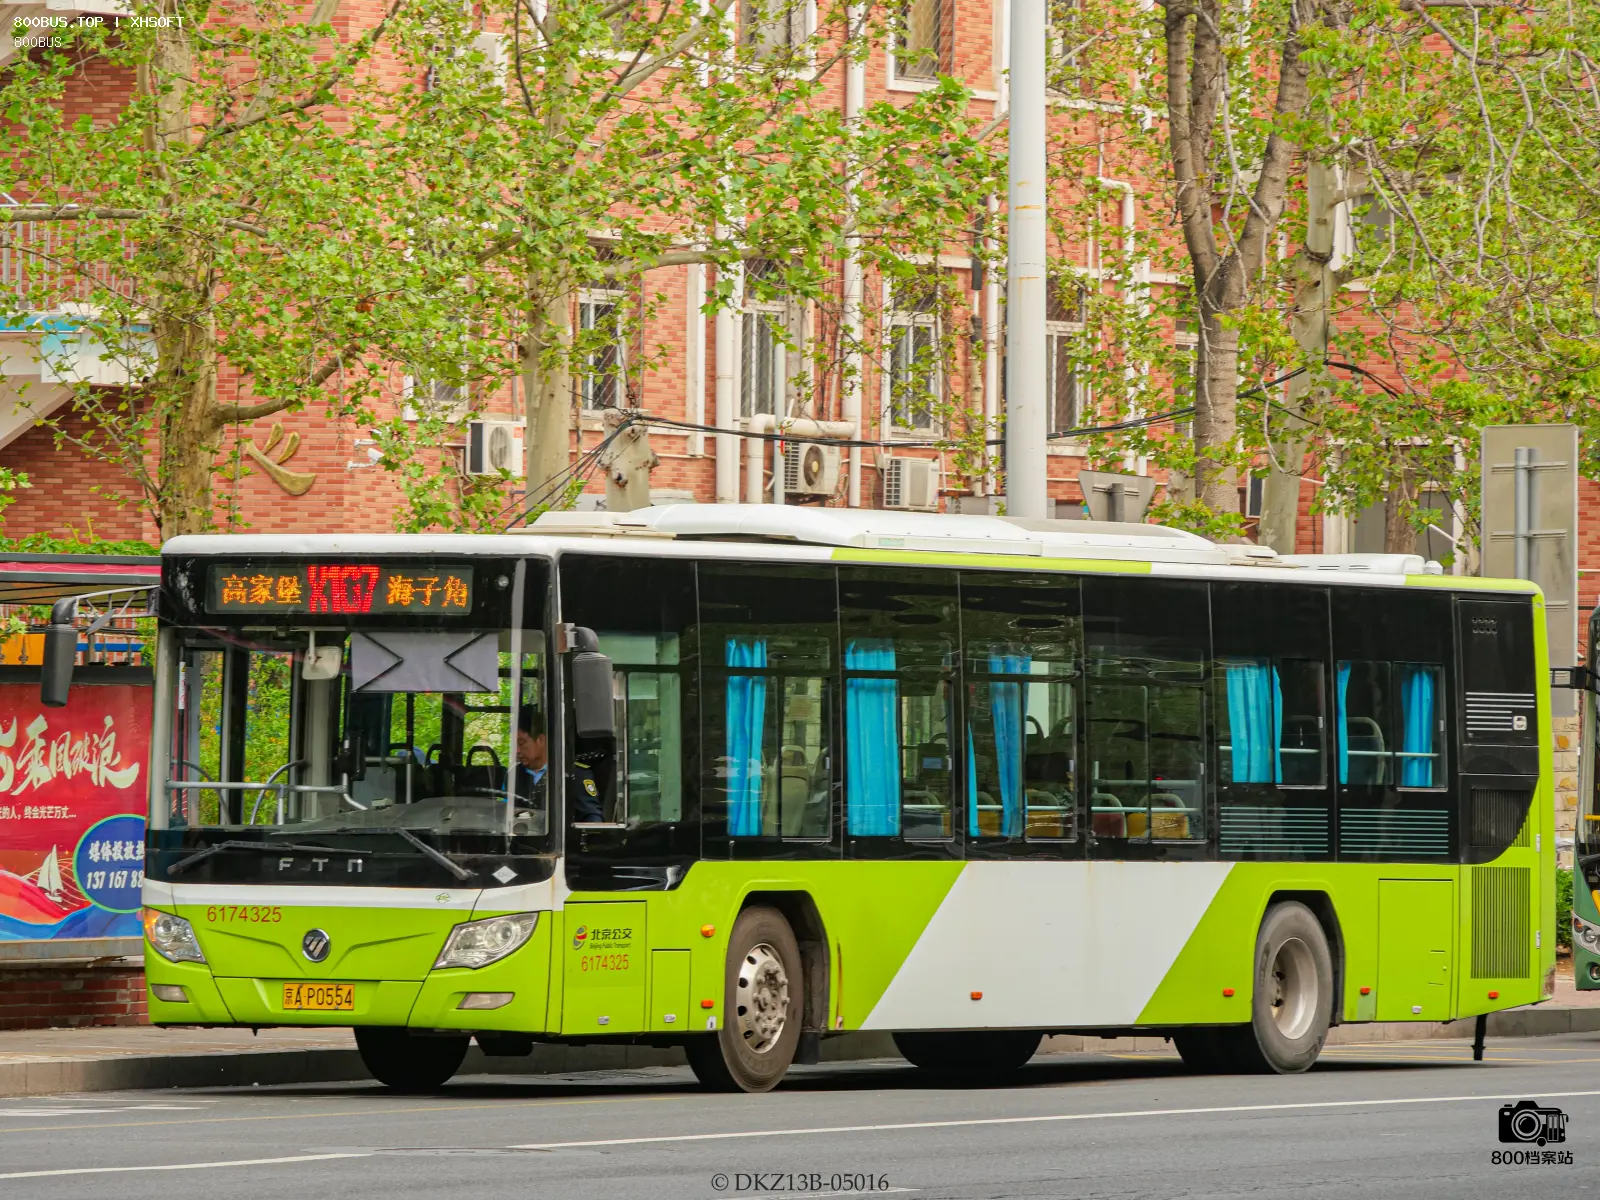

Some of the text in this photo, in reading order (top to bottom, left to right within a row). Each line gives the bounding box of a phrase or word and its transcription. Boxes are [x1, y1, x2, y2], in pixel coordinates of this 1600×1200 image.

[221, 573, 302, 604] 高家堡
[386, 575, 468, 608] 海子角
[86, 871, 106, 889] 137
[108, 870, 128, 889] 167
[206, 906, 282, 923] 6174325
[590, 928, 632, 940] 北京公交
[581, 953, 629, 972] 6174325
